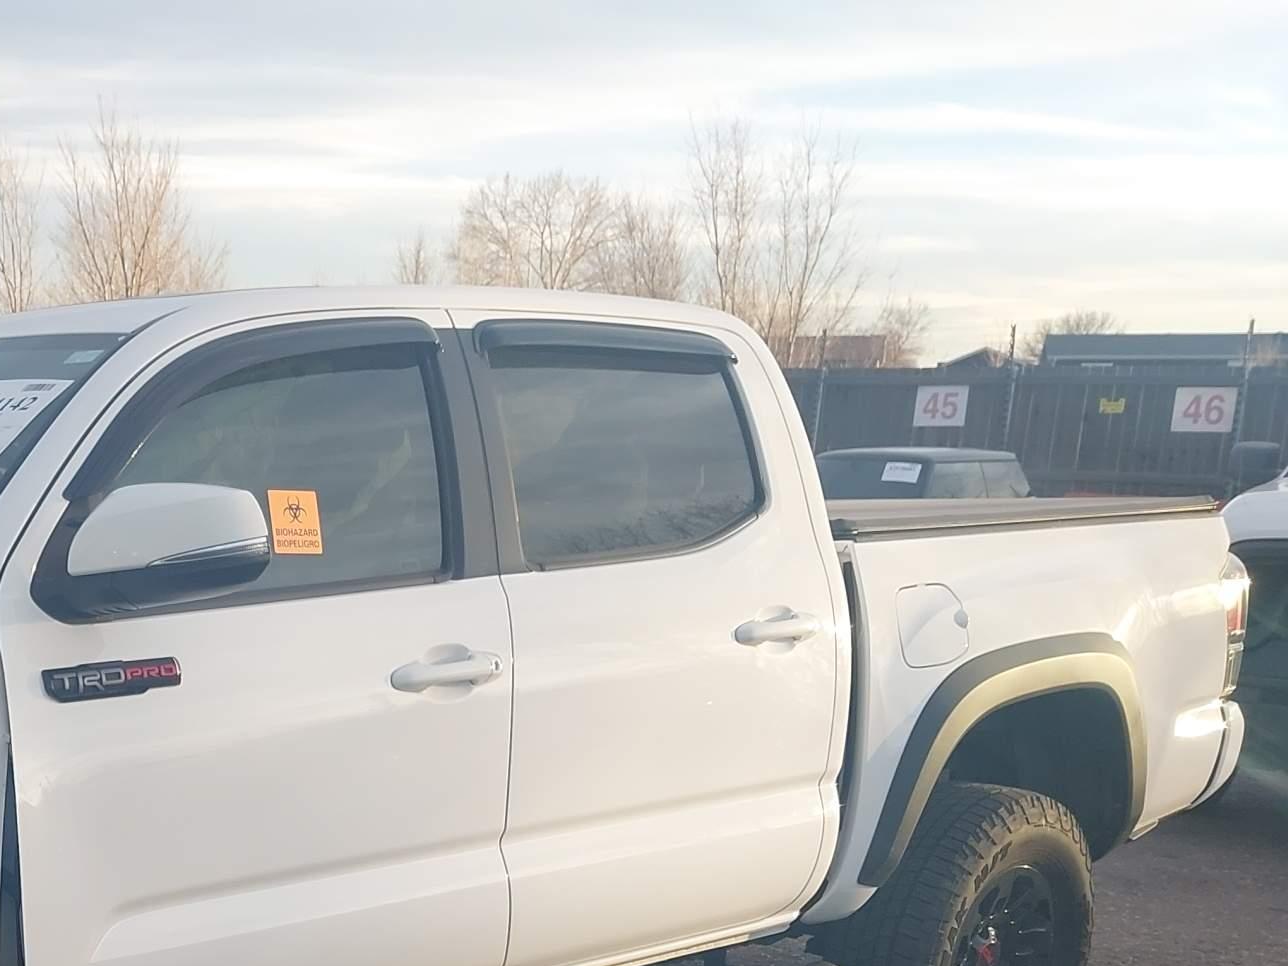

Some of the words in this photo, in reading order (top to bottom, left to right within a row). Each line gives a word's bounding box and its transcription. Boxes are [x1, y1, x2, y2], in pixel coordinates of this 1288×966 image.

[922, 391, 959, 419] 45
[1182, 394, 1225, 425] 46
[275, 528, 319, 536] BIOHAZARD
[276, 540, 320, 548] BIOPELIGRO
